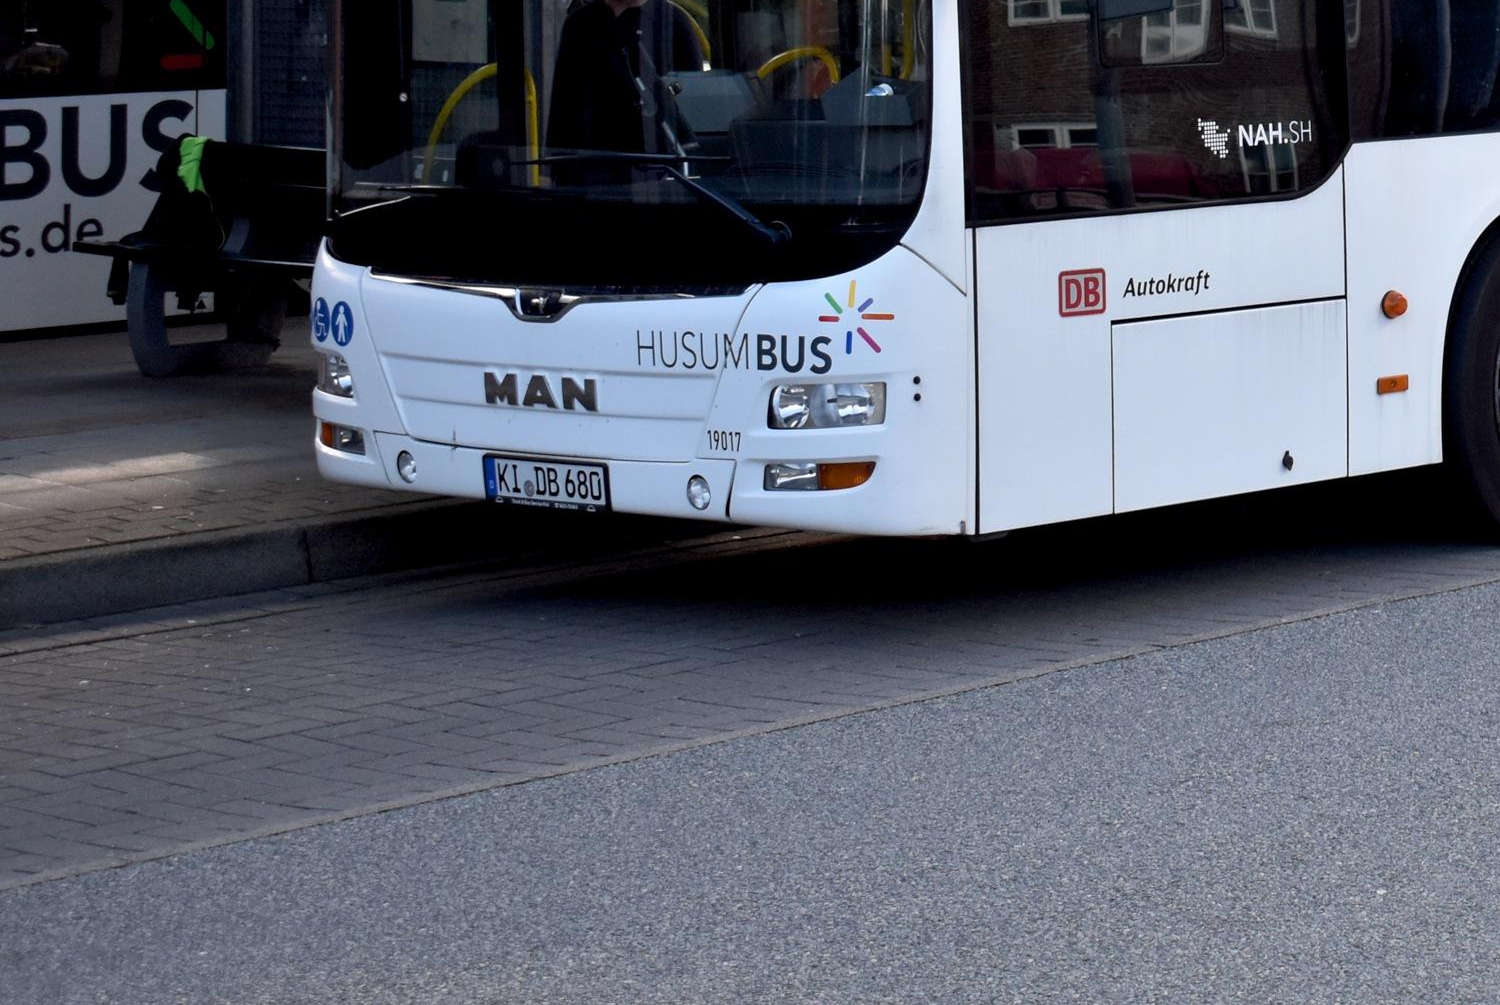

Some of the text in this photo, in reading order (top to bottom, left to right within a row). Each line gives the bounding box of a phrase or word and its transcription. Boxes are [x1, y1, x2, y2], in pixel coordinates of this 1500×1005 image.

[0, 99, 194, 201] BUS
[1238, 120, 1313, 147] NAH.SH
[1065, 276, 1100, 309] DB
[1123, 270, 1211, 298] Autokraft
[636, 329, 832, 375] HUSUMBUS
[484, 371, 599, 413] MAN
[707, 429, 741, 452] 19017
[497, 463, 602, 501] KI DB 680
